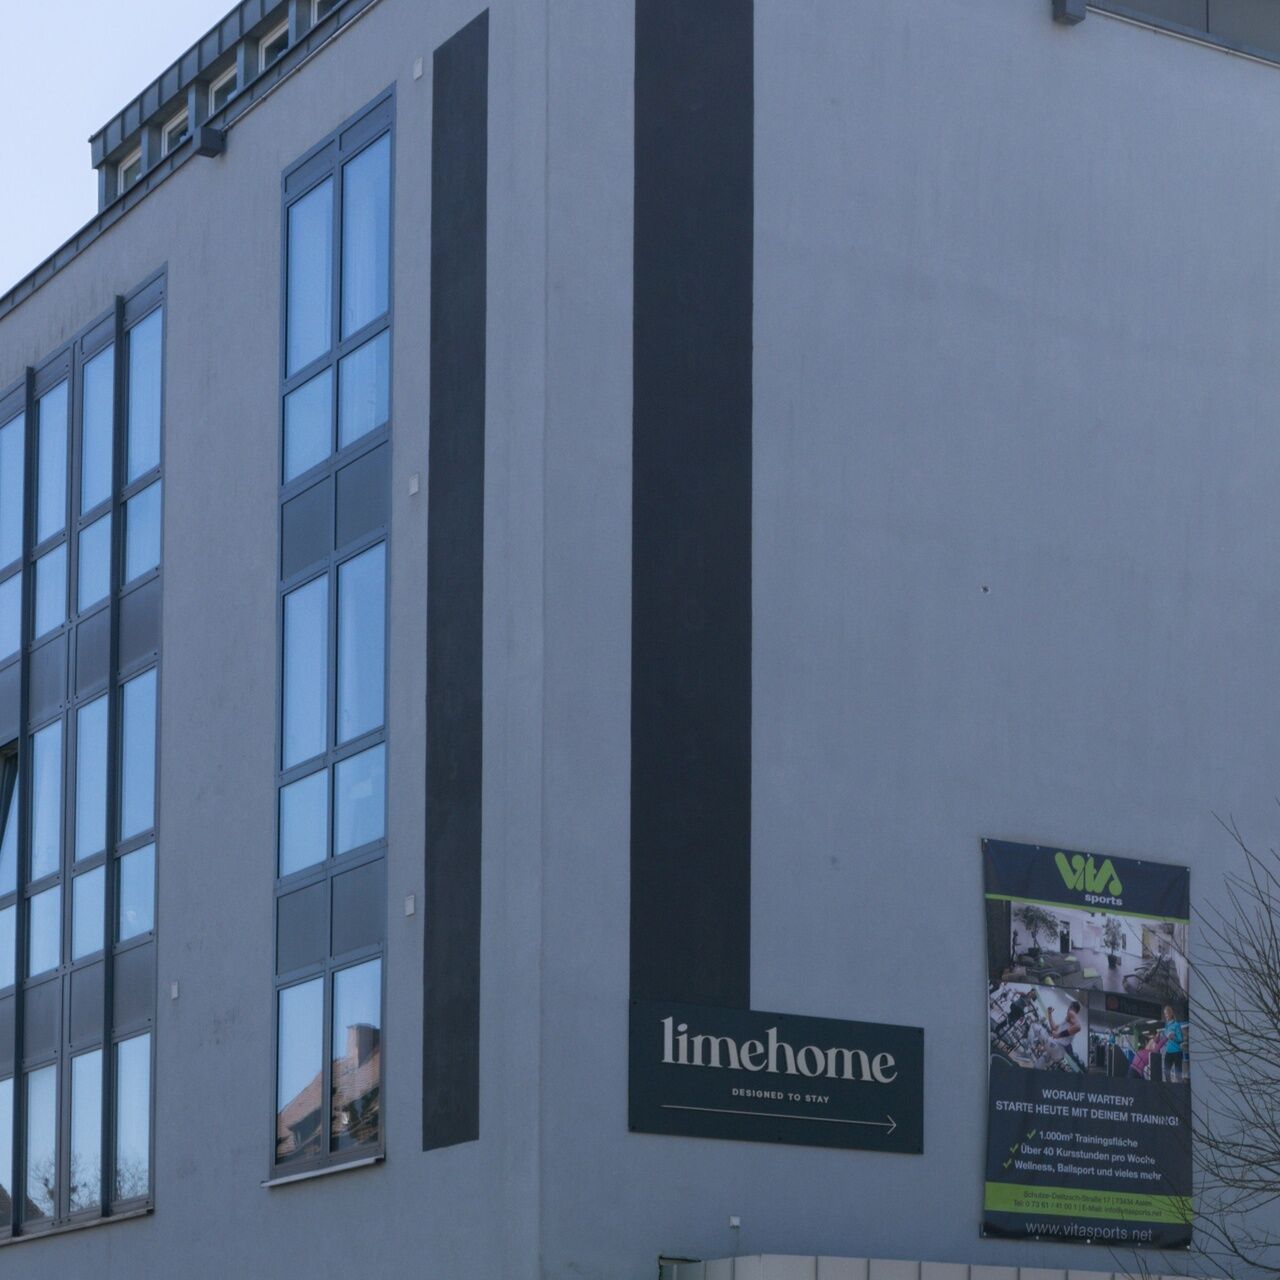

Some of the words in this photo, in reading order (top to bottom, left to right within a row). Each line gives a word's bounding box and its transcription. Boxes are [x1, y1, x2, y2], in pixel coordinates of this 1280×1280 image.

[1085, 893, 1123, 907] sports
[660, 1016, 898, 1084] limehome
[732, 1088, 784, 1101] DESIGNED
[788, 1092, 801, 1103] TO
[805, 1093, 830, 1105] STAY
[1042, 1089, 1085, 1102] WORAUF
[1087, 1093, 1134, 1106] WARTEN?
[996, 1101, 1033, 1113] STARTE
[1035, 1105, 1069, 1116] HEUTE
[1072, 1108, 1087, 1118] MIT
[1091, 1110, 1128, 1122] DEINEM
[1039, 1131, 1073, 1142] 1.000m²
[1075, 1134, 1138, 1148] Trainingsfläche
[1020, 1142, 1041, 1155] Über
[1043, 1145, 1054, 1156] 40
[1056, 1147, 1109, 1161] Kursstunden
[1111, 1153, 1125, 1165] pro
[1014, 1160, 1055, 1173] Wellness,
[1058, 1163, 1095, 1177] Ballsport
[1097, 1166, 1112, 1177] und
[1115, 1168, 1138, 1179] vieles
[1025, 1222, 1152, 1241] www.vitasportsnet
